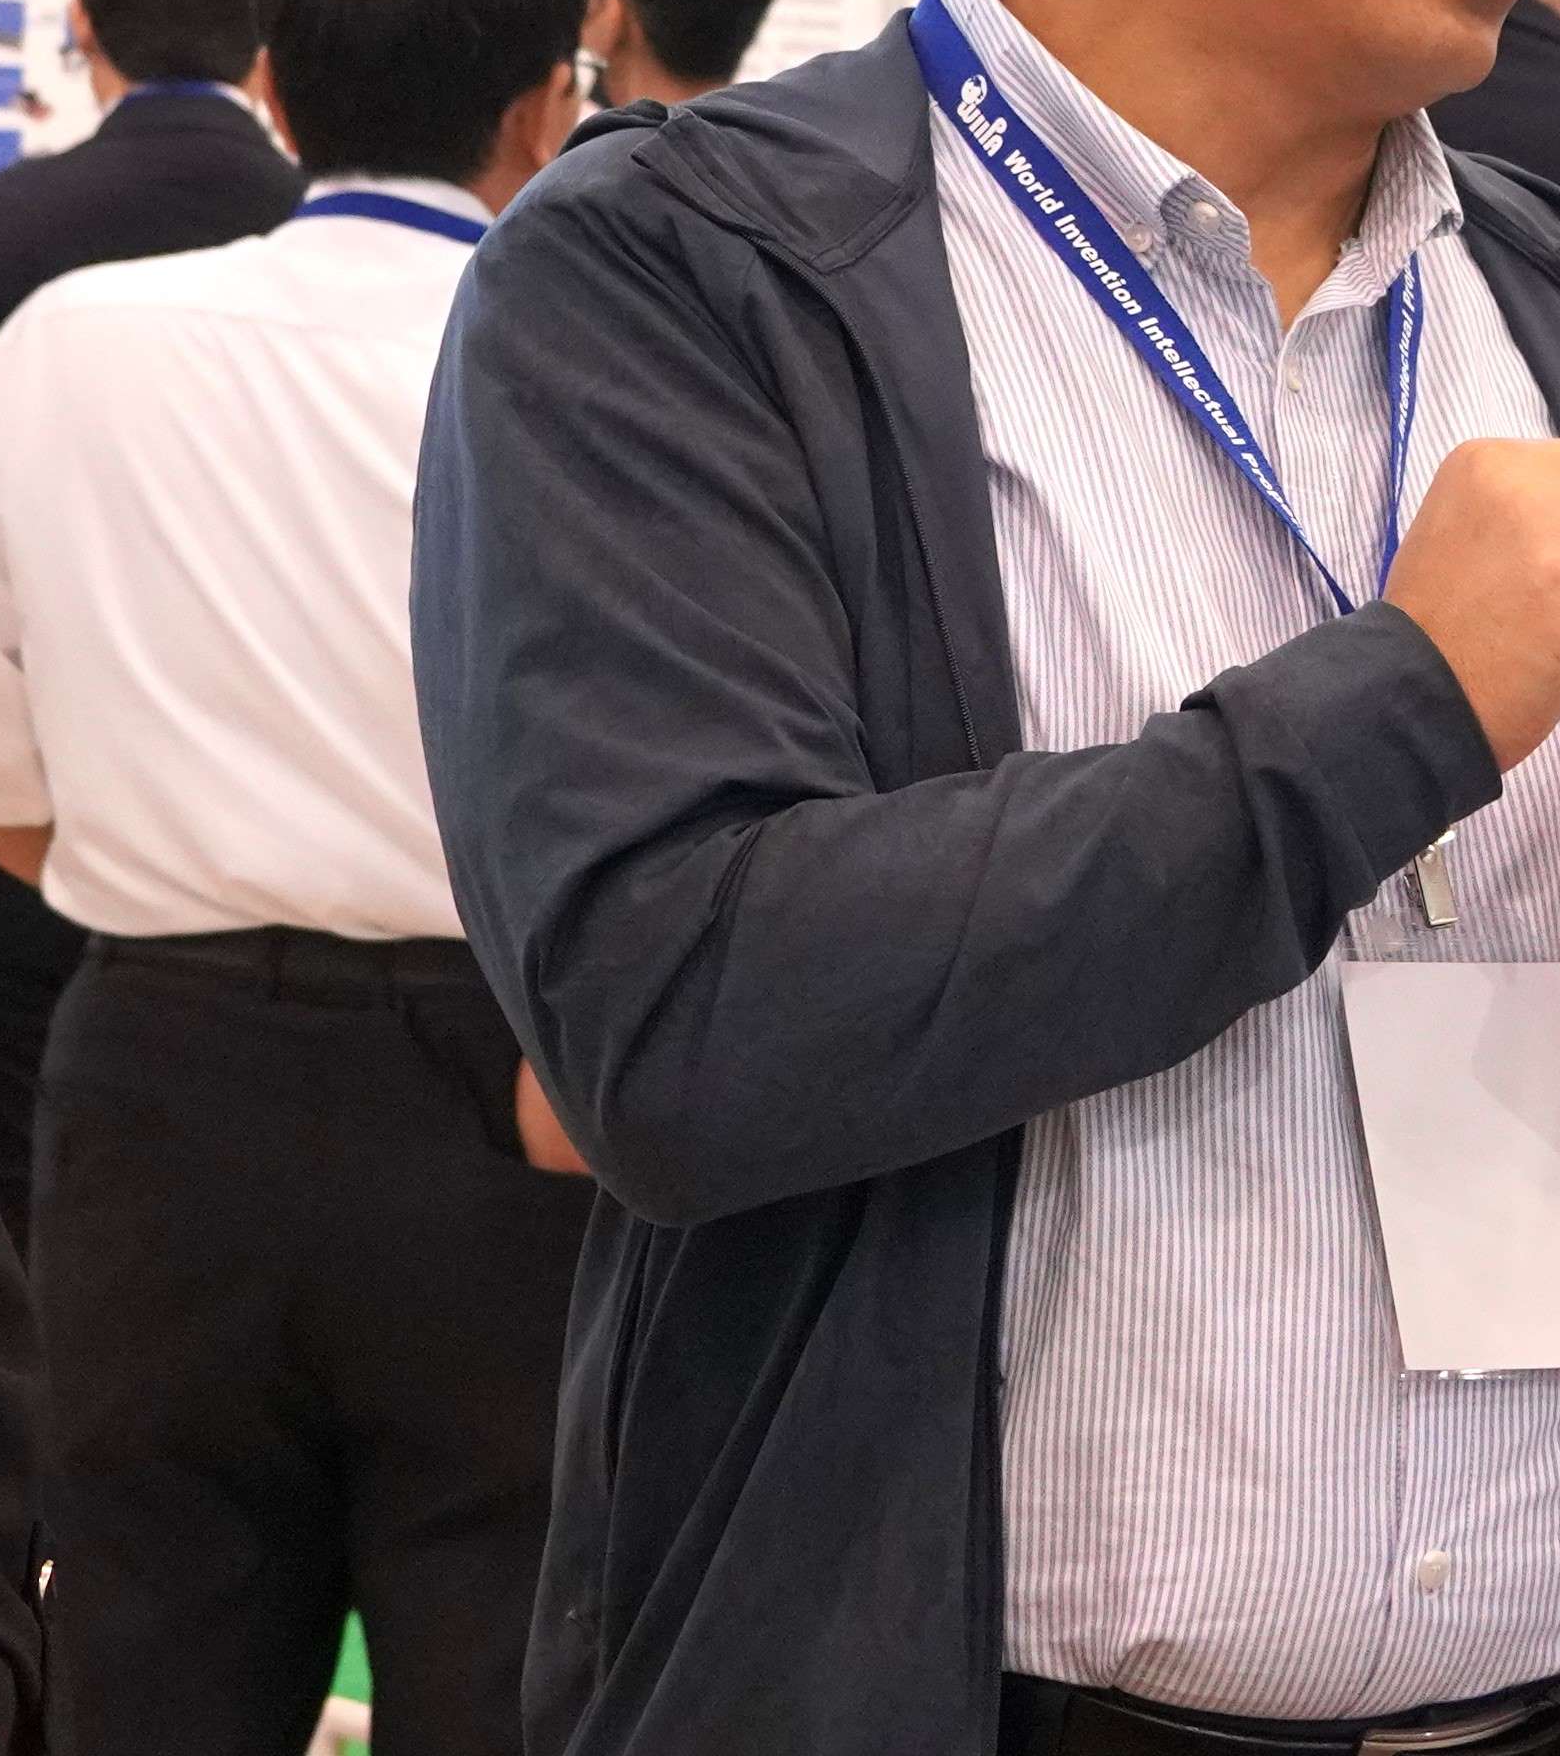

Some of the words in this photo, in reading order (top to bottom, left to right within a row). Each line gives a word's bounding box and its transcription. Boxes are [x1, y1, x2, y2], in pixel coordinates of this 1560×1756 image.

[1004, 149, 1065, 215] World
[1054, 214, 1143, 316] Invention
[1138, 317, 1246, 447] Intellectual
[1401, 265, 1417, 313] Prop
